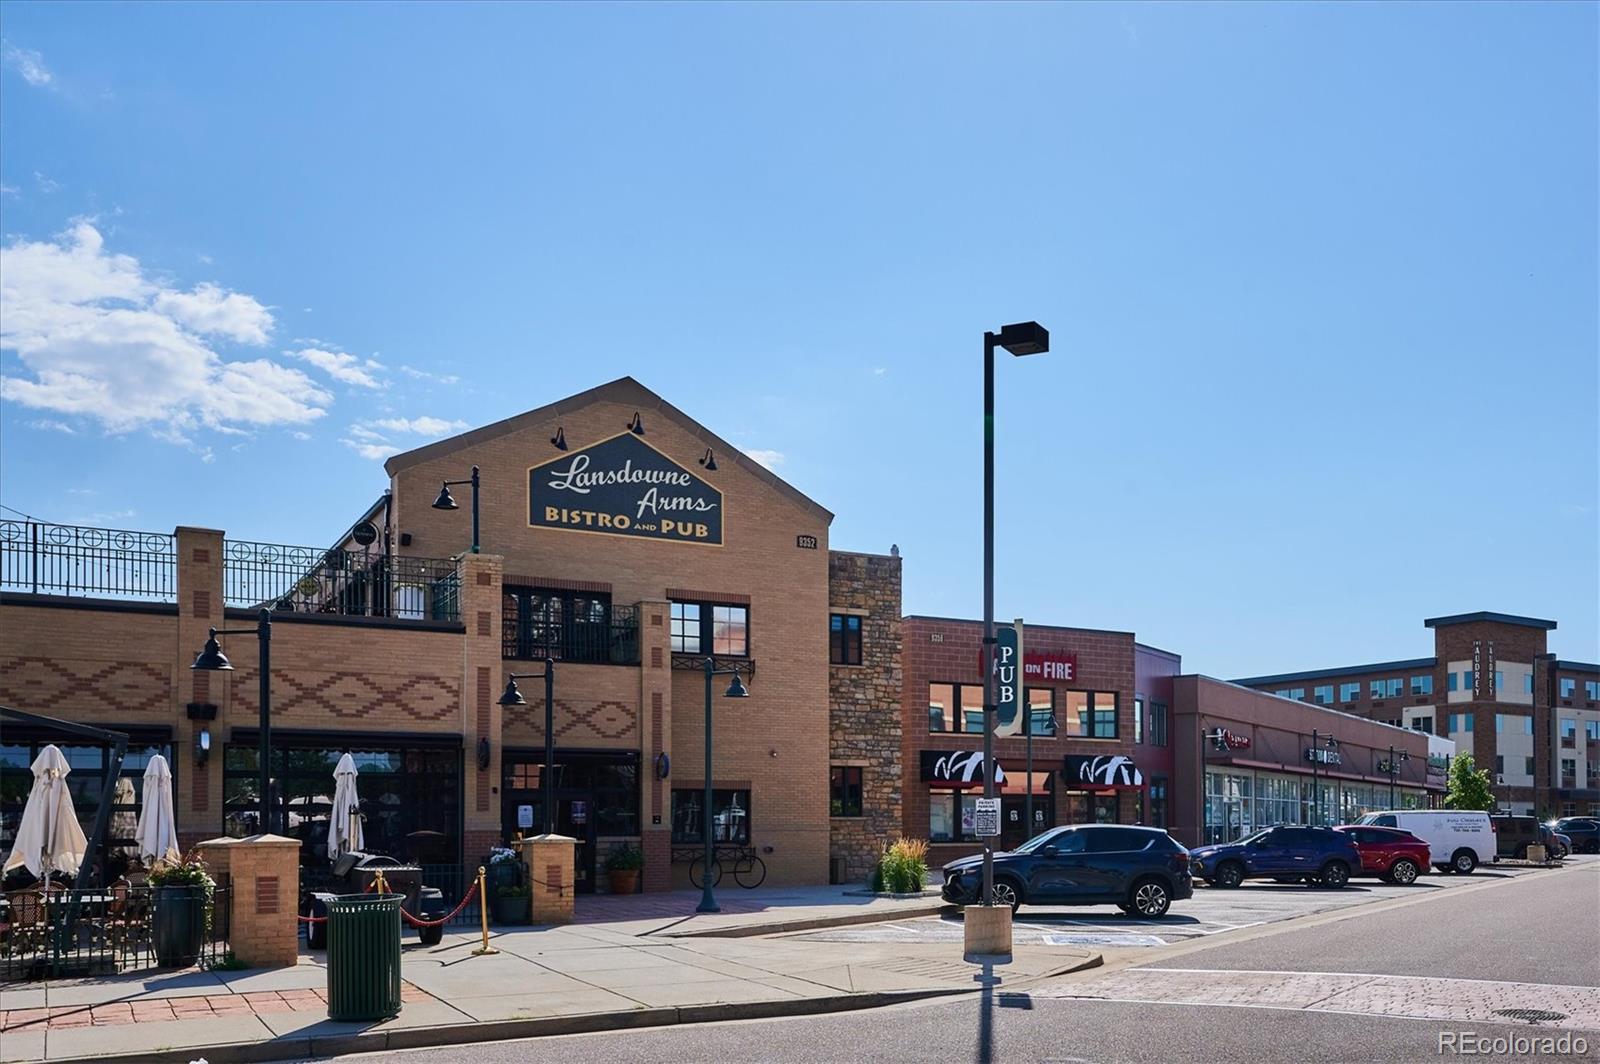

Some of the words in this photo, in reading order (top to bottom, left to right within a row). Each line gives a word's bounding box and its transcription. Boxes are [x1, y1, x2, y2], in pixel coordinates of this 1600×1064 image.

[548, 454, 691, 494] Lansdowne
[636, 487, 718, 519] Arms
[545, 506, 631, 530] BISTRO
[634, 523, 657, 532] AND
[661, 519, 709, 538] PUB
[999, 646, 1014, 703] PUB
[1025, 664, 1041, 674] ON
[1043, 661, 1073, 680] FIRE
